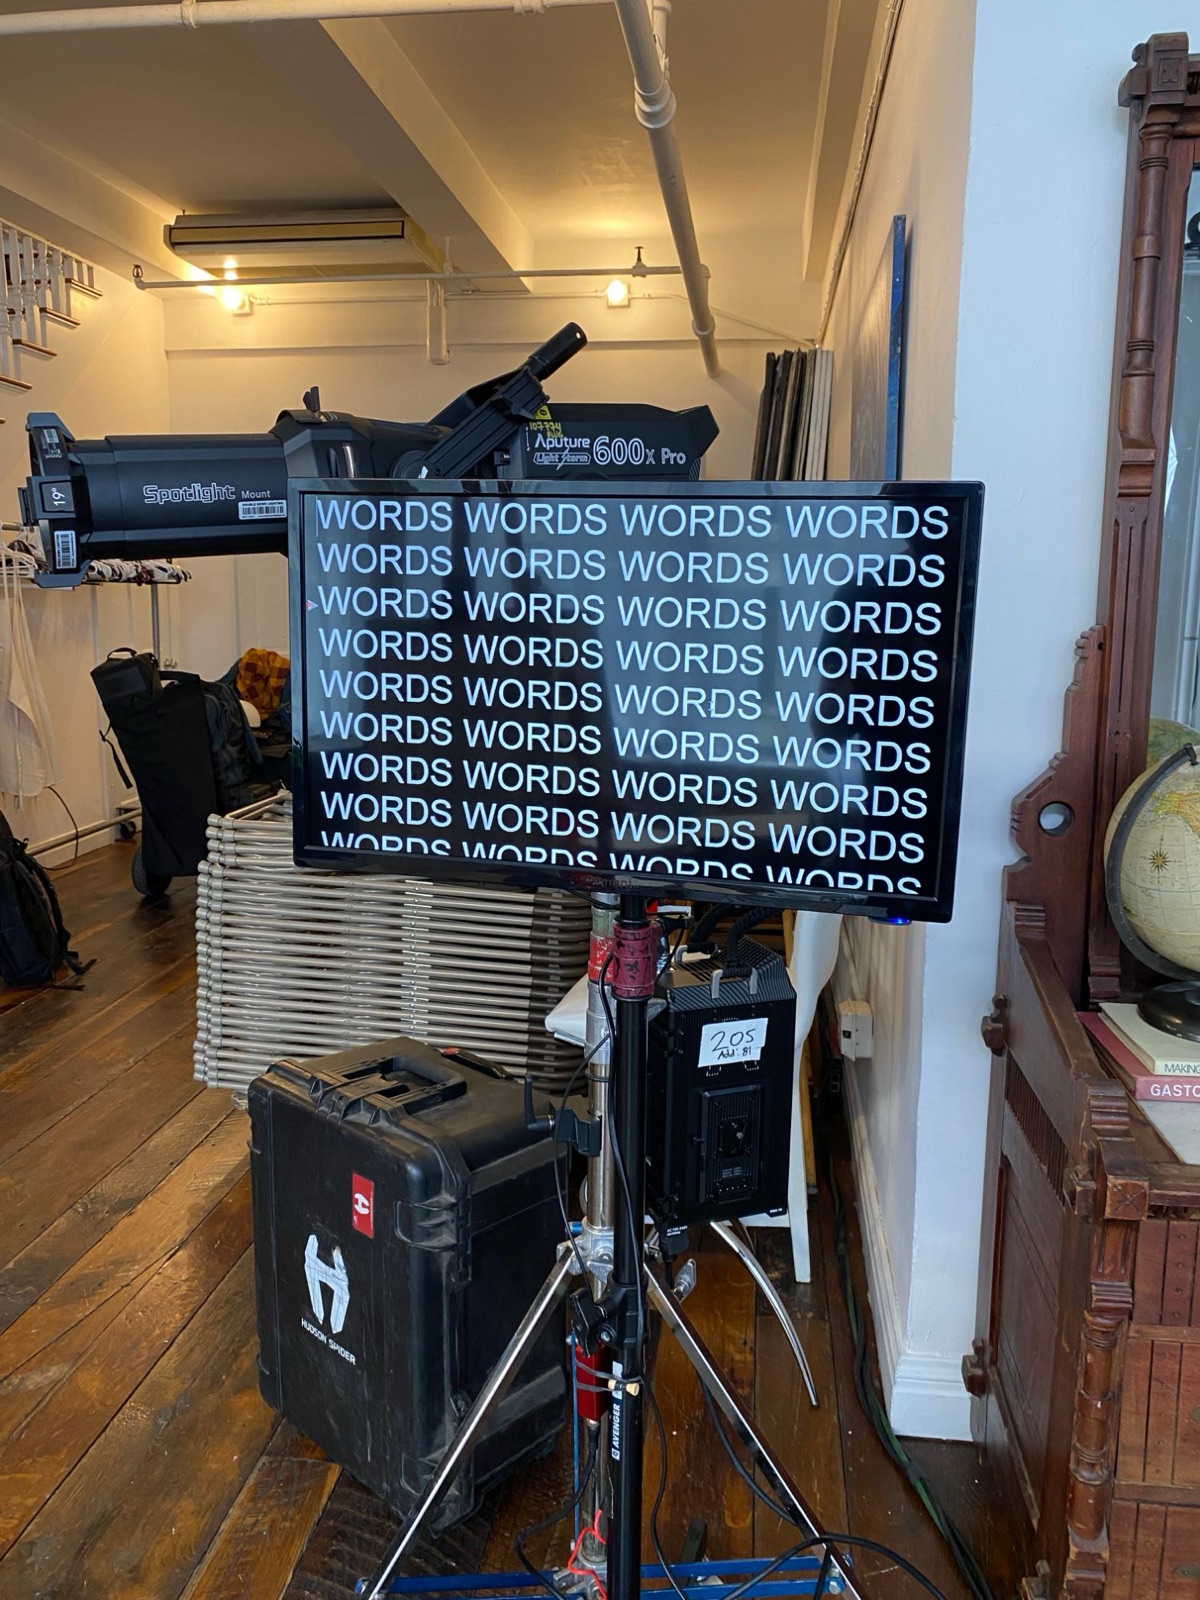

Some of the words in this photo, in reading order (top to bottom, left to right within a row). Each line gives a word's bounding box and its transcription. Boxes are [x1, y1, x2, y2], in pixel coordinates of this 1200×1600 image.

[535, 433, 590, 450] Aputure
[661, 448, 686, 464] Pro
[143, 482, 235, 504] Spotlight
[241, 490, 271, 499] Mount
[317, 499, 452, 532] WORDS
[464, 502, 606, 535] WORDS
[620, 505, 771, 537] WORDS
[786, 506, 948, 539] WORDS
[318, 543, 452, 576] WORDS
[464, 547, 605, 580] WORDS
[619, 551, 768, 584] WORDS
[783, 553, 945, 588] WORDS
[318, 586, 452, 619] WORDS
[464, 591, 604, 625] WORDS
[617, 596, 766, 630] WORDS
[781, 600, 941, 635] WORDS
[319, 628, 452, 662] WORDS
[463, 634, 603, 669] WORDS
[616, 641, 763, 675] WORDS
[778, 646, 938, 682] WORDS
[320, 670, 452, 704] WORDS
[463, 677, 602, 712] WORDS
[615, 684, 761, 720] WORDS
[775, 691, 934, 728] WORDS
[320, 711, 452, 746] WORDS
[463, 719, 601, 755] WORDS
[613, 727, 759, 764] WORDS
[773, 736, 931, 774] WORDS
[320, 751, 452, 787] WORDS
[463, 760, 600, 797] WORDS
[612, 769, 757, 807] WORDS
[770, 779, 927, 819] WORDS
[320, 791, 452, 827] WORDS
[462, 801, 599, 838] WORDS
[611, 812, 755, 850] WORDS
[768, 823, 924, 863] WORDS
[321, 831, 451, 856] WORDS
[462, 842, 598, 867] WORDS
[610, 853, 753, 880] WORDS
[766, 866, 921, 895] WORDS
[710, 1028, 756, 1052] 205
[742, 1045, 752, 1057] 81
[301, 1318, 327, 1344] HUDSON
[328, 1338, 356, 1365] SPIDER
[612, 1403, 620, 1448] AVENGER
